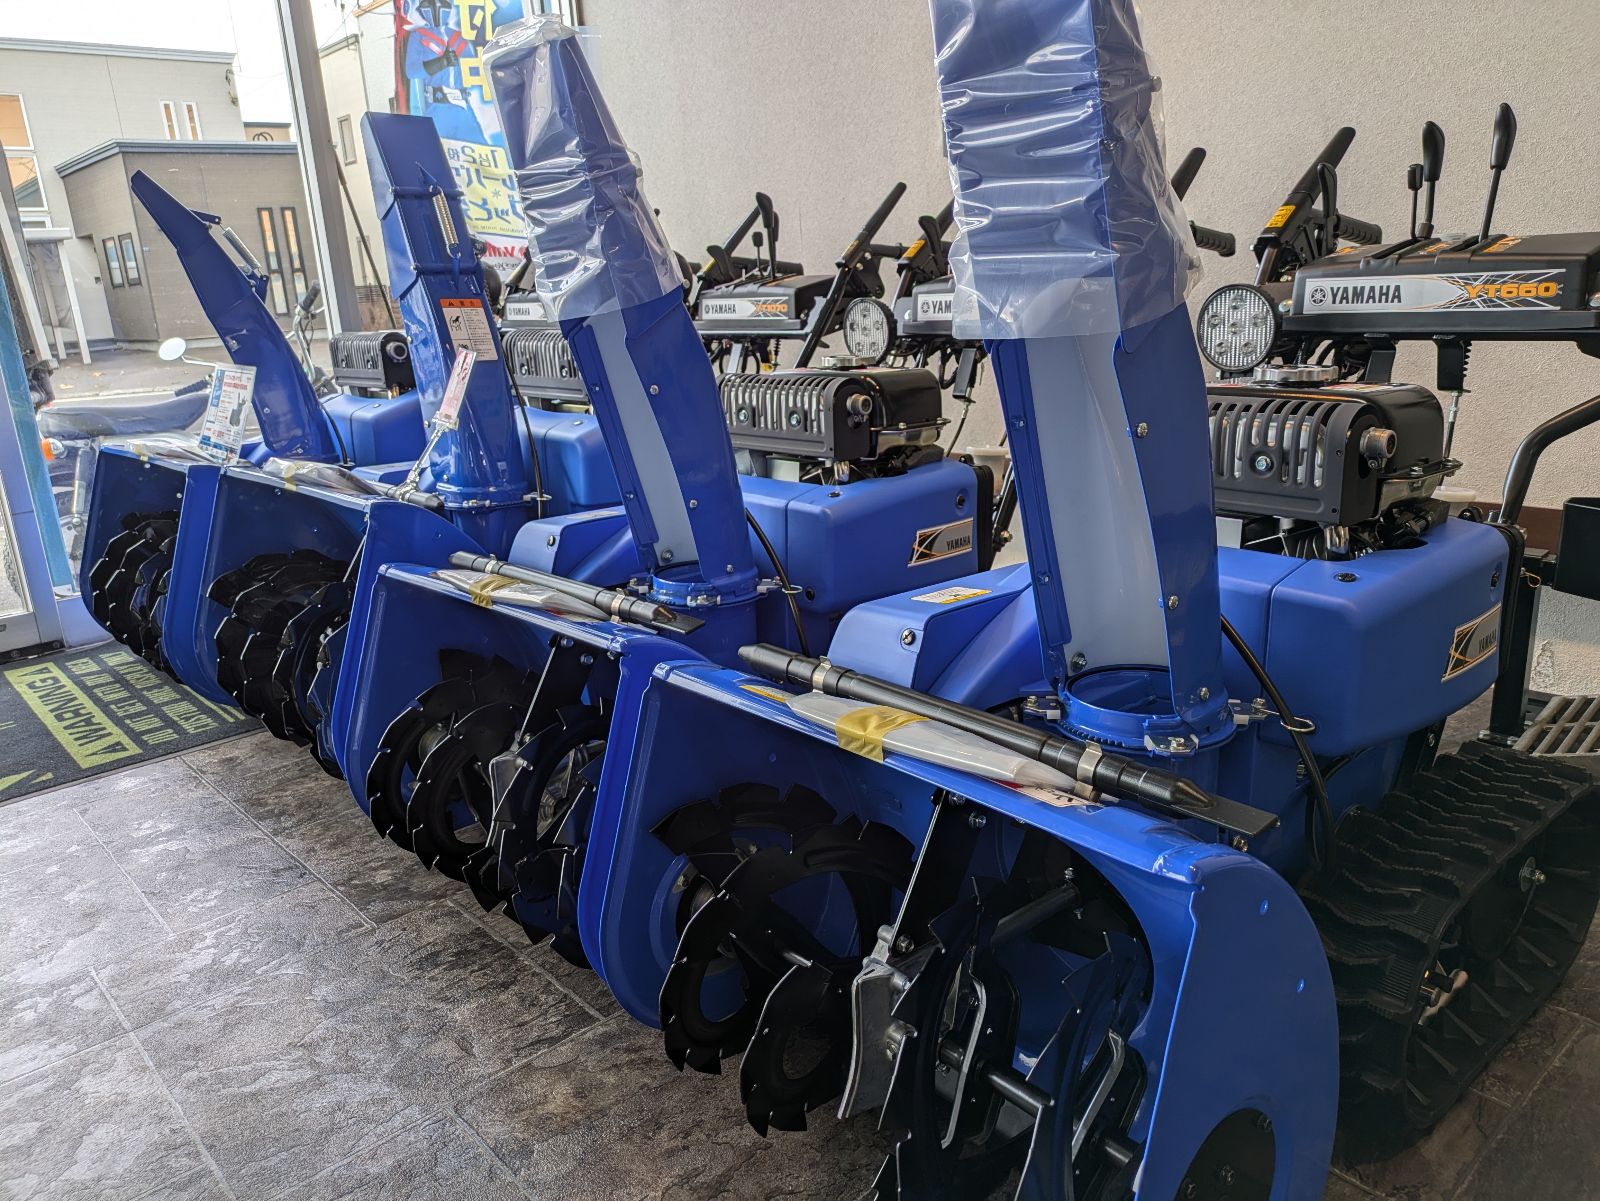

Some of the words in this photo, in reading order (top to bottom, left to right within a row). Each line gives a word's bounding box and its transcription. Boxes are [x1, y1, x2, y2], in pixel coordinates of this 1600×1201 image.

[1330, 284, 1402, 304] YAMAHA
[1464, 281, 1559, 300] YT660
[512, 307, 531, 316] YAMAHA
[710, 304, 737, 314] YAMAHA
[755, 303, 788, 313] YT1070
[932, 300, 952, 314] YAM
[946, 534, 971, 551] YAMAHA
[114, 663, 162, 687] DISPLAY
[93, 683, 130, 701] INTO
[143, 686, 181, 703] BIKE
[26, 676, 114, 745] WARNING
[111, 699, 146, 715] GET
[126, 713, 164, 731] NOT
[162, 701, 218, 732] CUSTOM
[143, 729, 178, 744] DO
